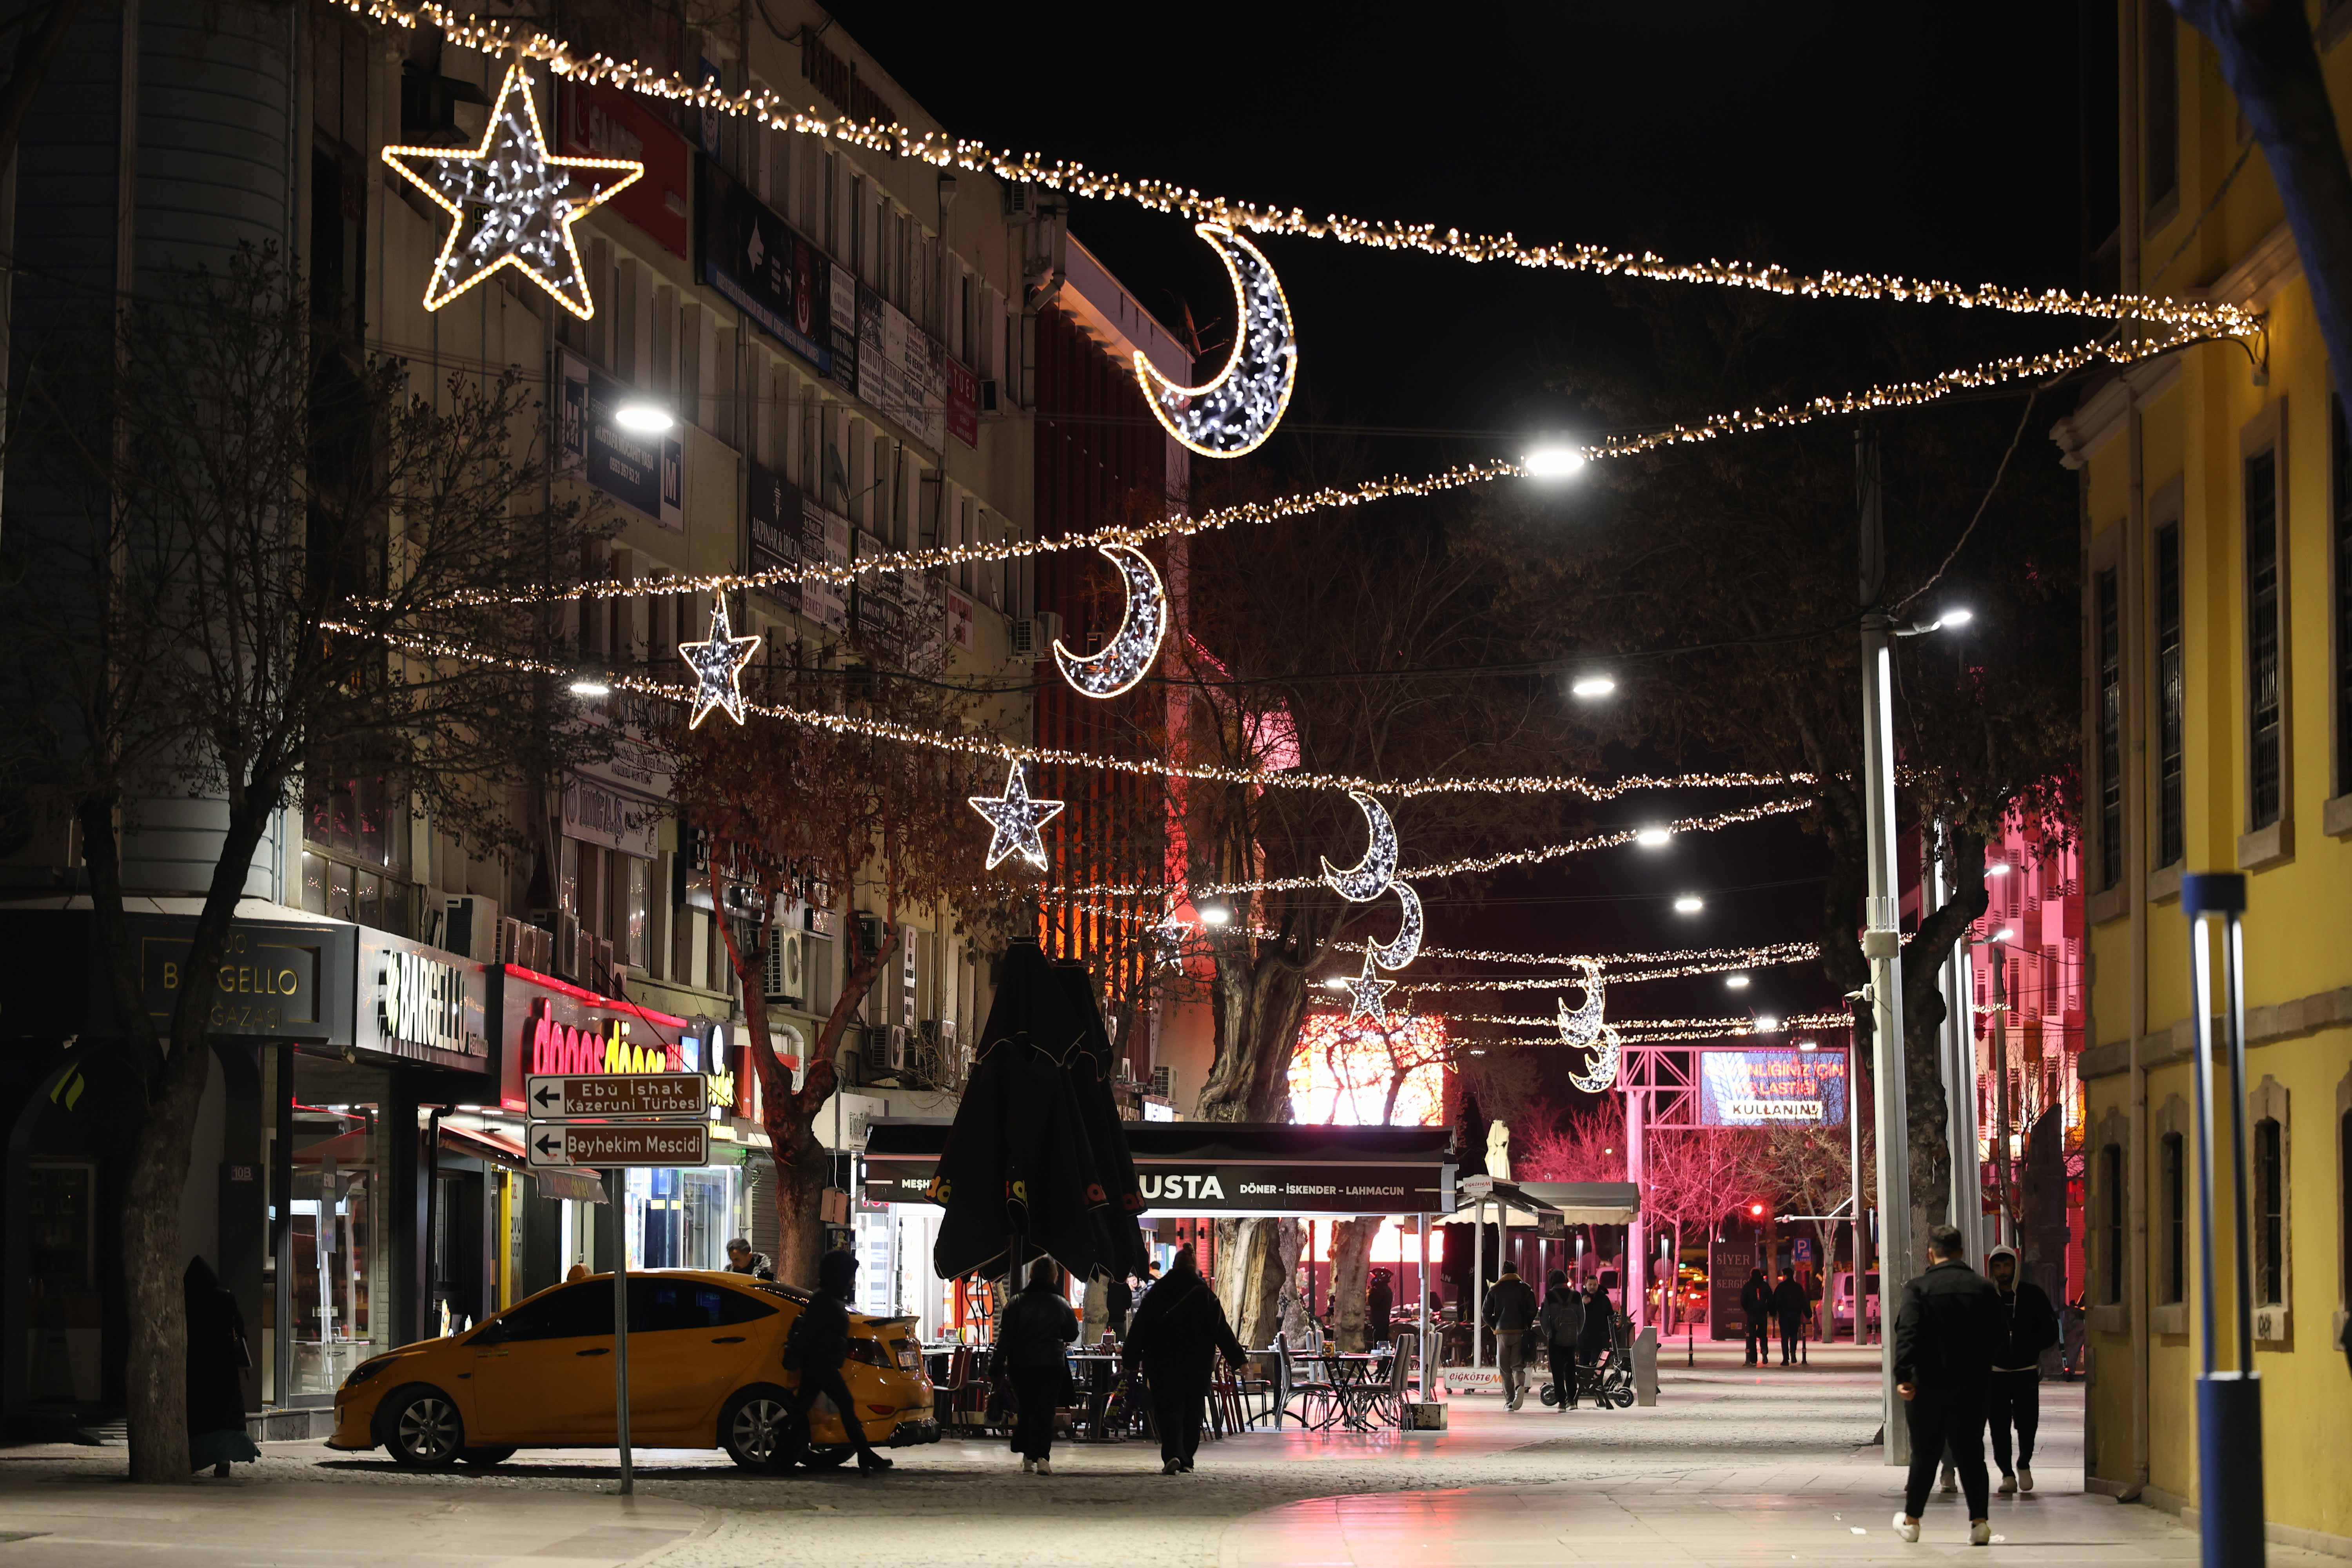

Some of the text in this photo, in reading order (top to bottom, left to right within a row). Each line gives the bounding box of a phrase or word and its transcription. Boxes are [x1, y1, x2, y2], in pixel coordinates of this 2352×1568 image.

[860, 341, 882, 370] UMUT
[595, 425, 618, 451] MUSTAFA
[752, 516, 778, 548] AKPINAR
[778, 532, 783, 552] &
[783, 526, 802, 563] İBİCAN
[164, 962, 299, 995] BGELLO
[399, 951, 468, 1053] BARGELLO
[211, 1001, 282, 1029] ĞAZASI
[469, 1032, 489, 1058] Perfume
[1814, 1061, 1845, 1080] İÇİN
[583, 1079, 683, 1097] Ebû İshak
[1759, 1079, 1816, 1095] LASTİĞİ
[566, 1096, 700, 1112] Kâzeruni Türbesi
[568, 1134, 700, 1157] Beyhekim Mescidi
[232, 1166, 251, 1179] 10B
[902, 1179, 931, 1191] MEŞH
[1138, 1174, 1225, 1200] USTA
[1240, 1182, 1276, 1195] DÖNER
[1286, 1182, 1336, 1196] İSKENDER
[1346, 1185, 1404, 1196] LAHMACUN
[1797, 1240, 1807, 1254] P
[1716, 1252, 1750, 1265] SİYER
[1716, 1278, 1749, 1289] SERGİS
